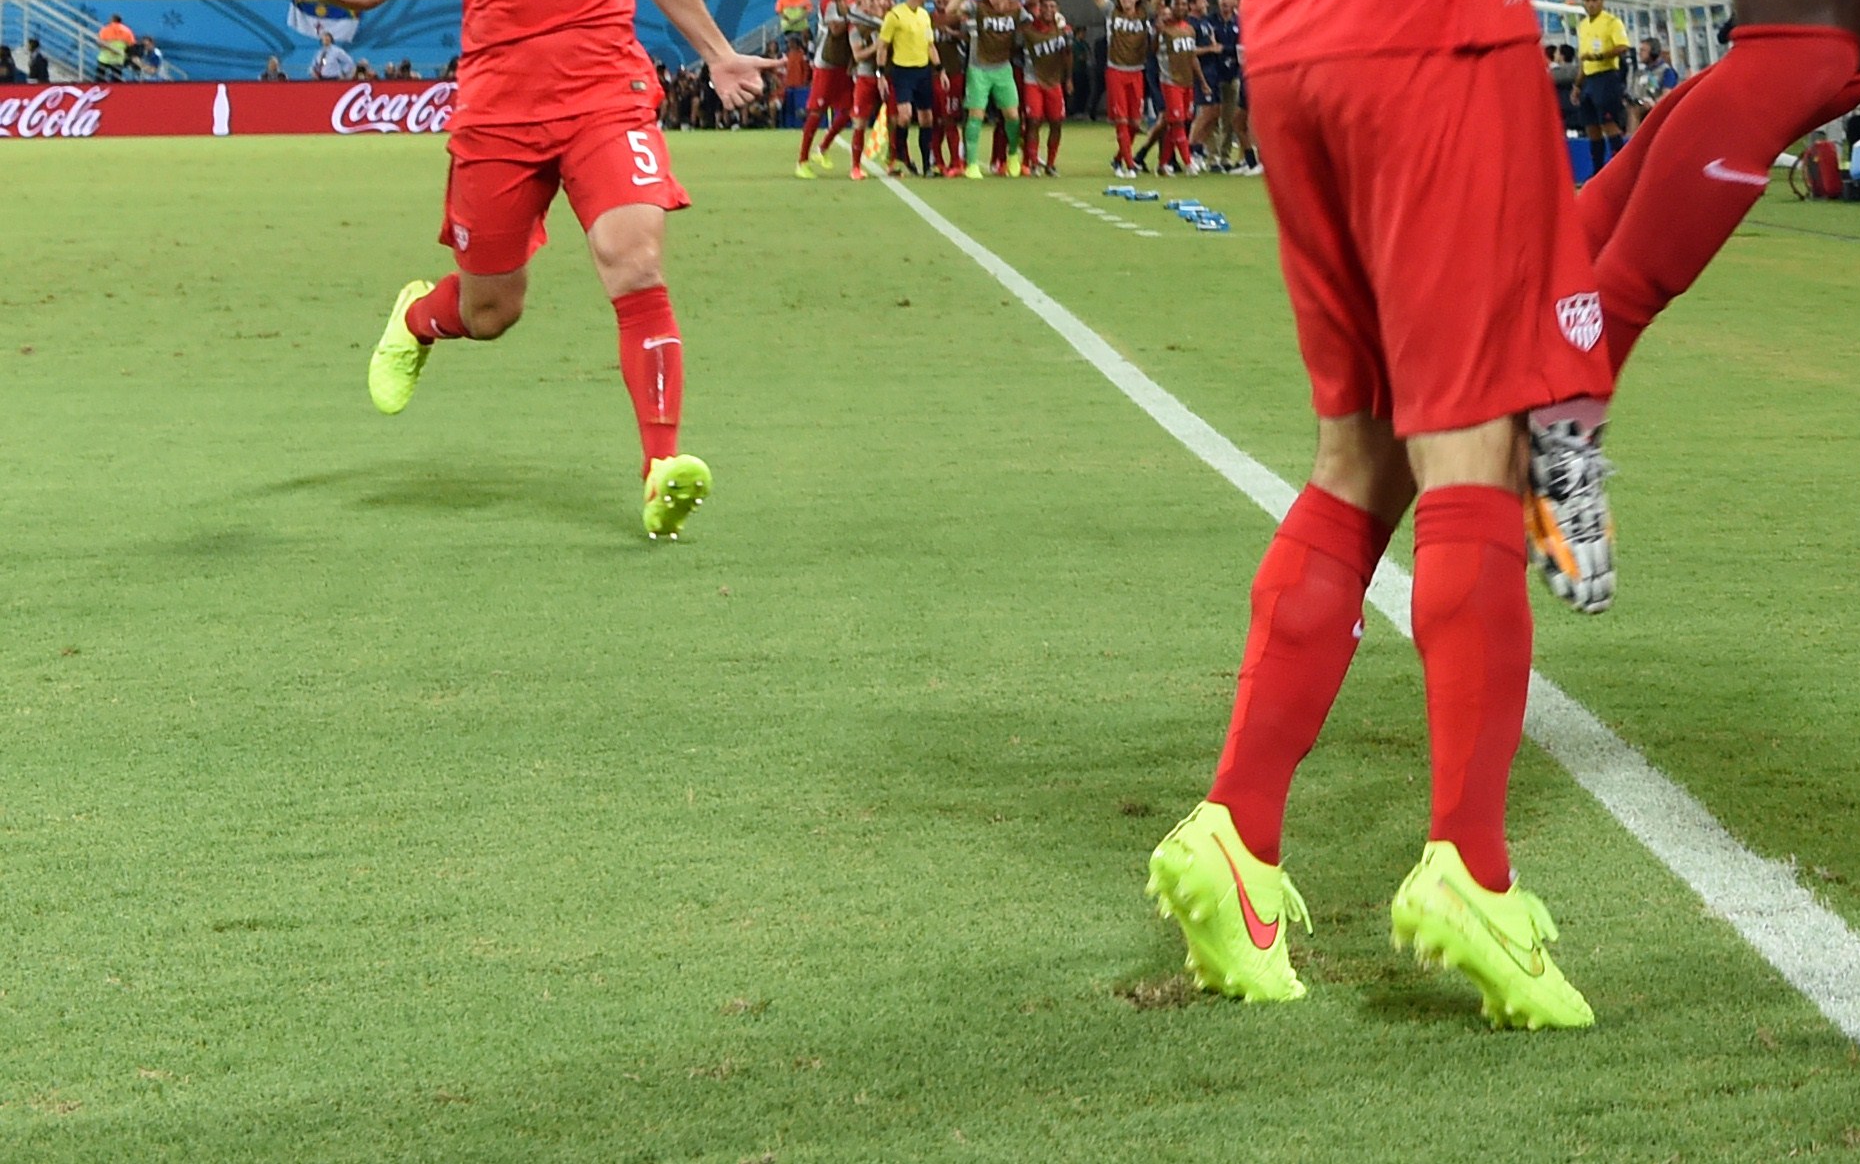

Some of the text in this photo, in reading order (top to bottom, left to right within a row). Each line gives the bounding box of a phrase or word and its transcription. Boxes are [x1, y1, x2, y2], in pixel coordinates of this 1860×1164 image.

[983, 16, 1016, 32] FIFA
[1114, 17, 1144, 33] FIFA
[1034, 36, 1067, 57] FIFA
[1173, 37, 1196, 53] FIF
[332, 82, 458, 133] Coca-Co
[627, 130, 658, 175] 5
